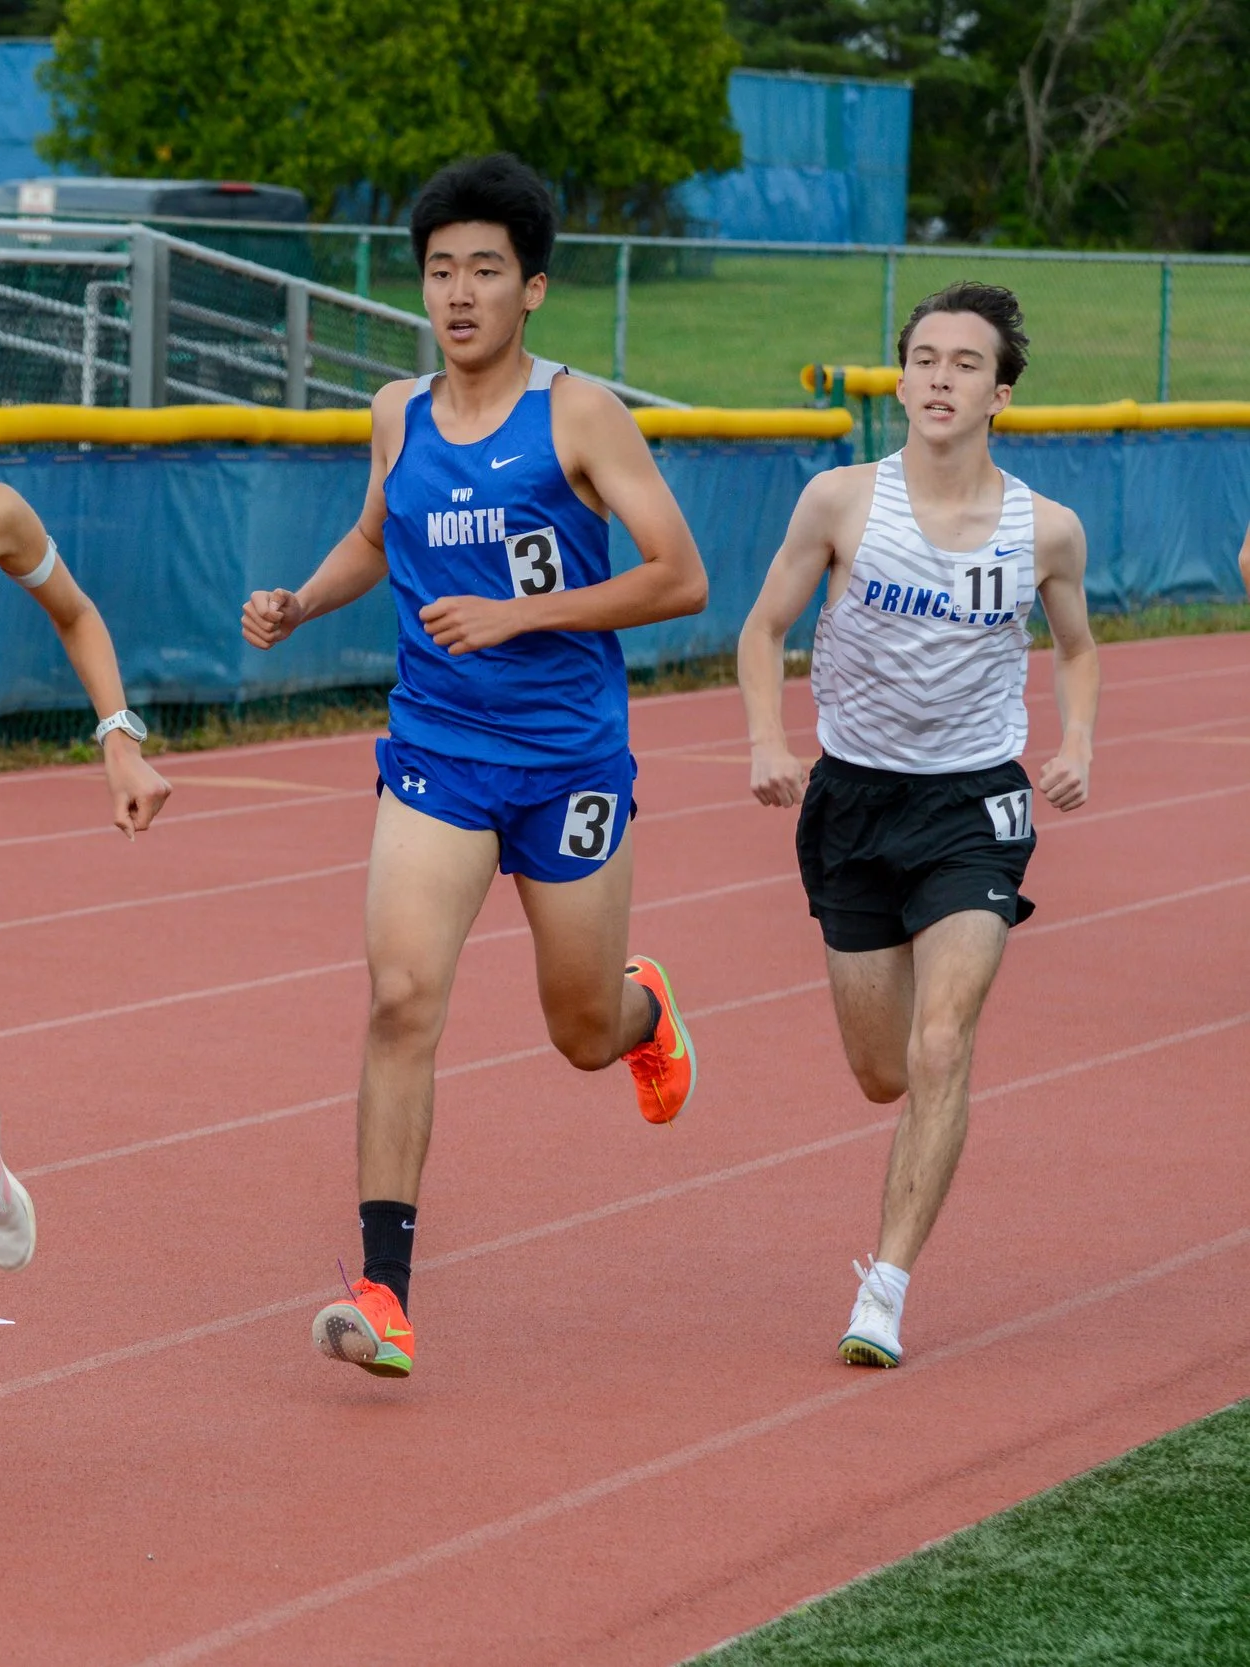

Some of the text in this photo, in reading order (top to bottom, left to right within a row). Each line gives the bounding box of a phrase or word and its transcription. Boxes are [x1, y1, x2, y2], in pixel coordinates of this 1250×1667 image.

[452, 488, 473, 502] WWP
[428, 508, 505, 547] NORTH
[514, 534, 557, 596] 3
[864, 580, 1019, 626] PRINC
[965, 566, 1002, 610] 11
[569, 795, 610, 857] 3
[996, 792, 1027, 836] 11
